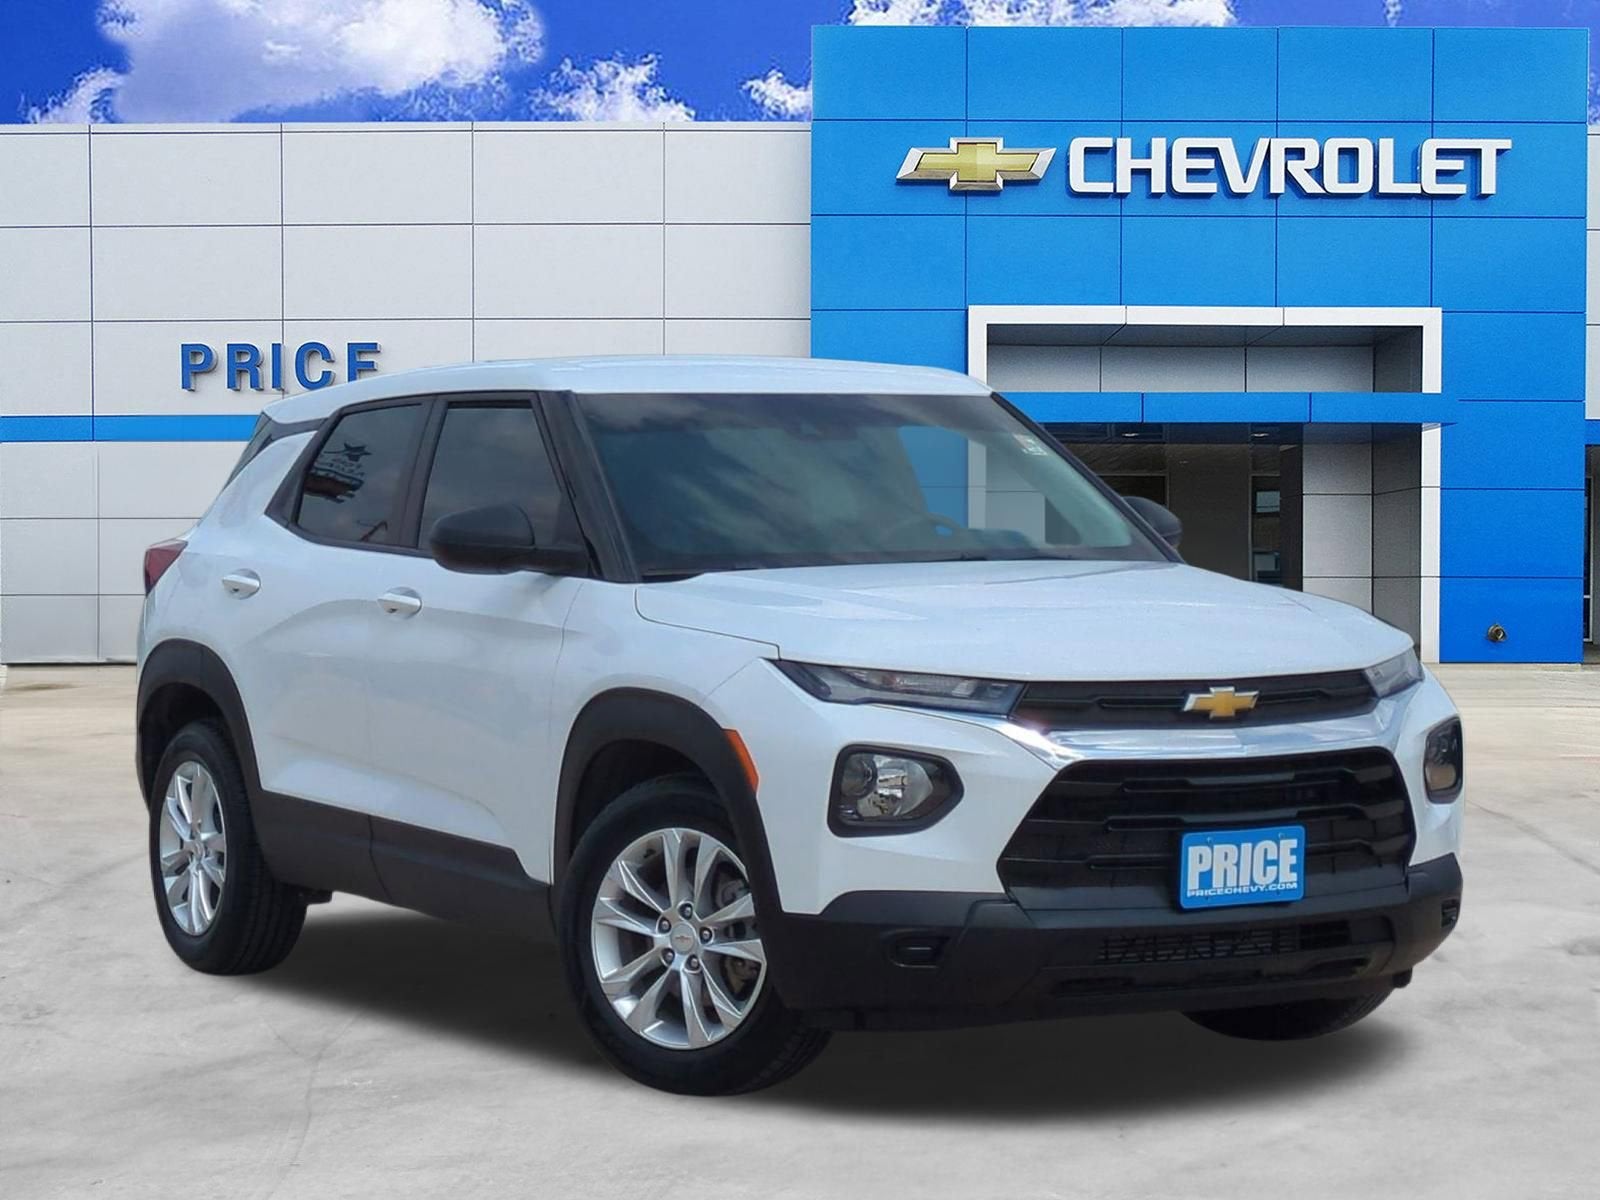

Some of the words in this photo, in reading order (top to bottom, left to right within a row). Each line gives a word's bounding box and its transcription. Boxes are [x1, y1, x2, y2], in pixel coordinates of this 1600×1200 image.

[1069, 137, 1512, 195] CHEVROLET
[181, 341, 381, 391] PRICE
[1187, 838, 1298, 890] PRICE
[1186, 882, 1298, 898] PRICECHEVY.COM
